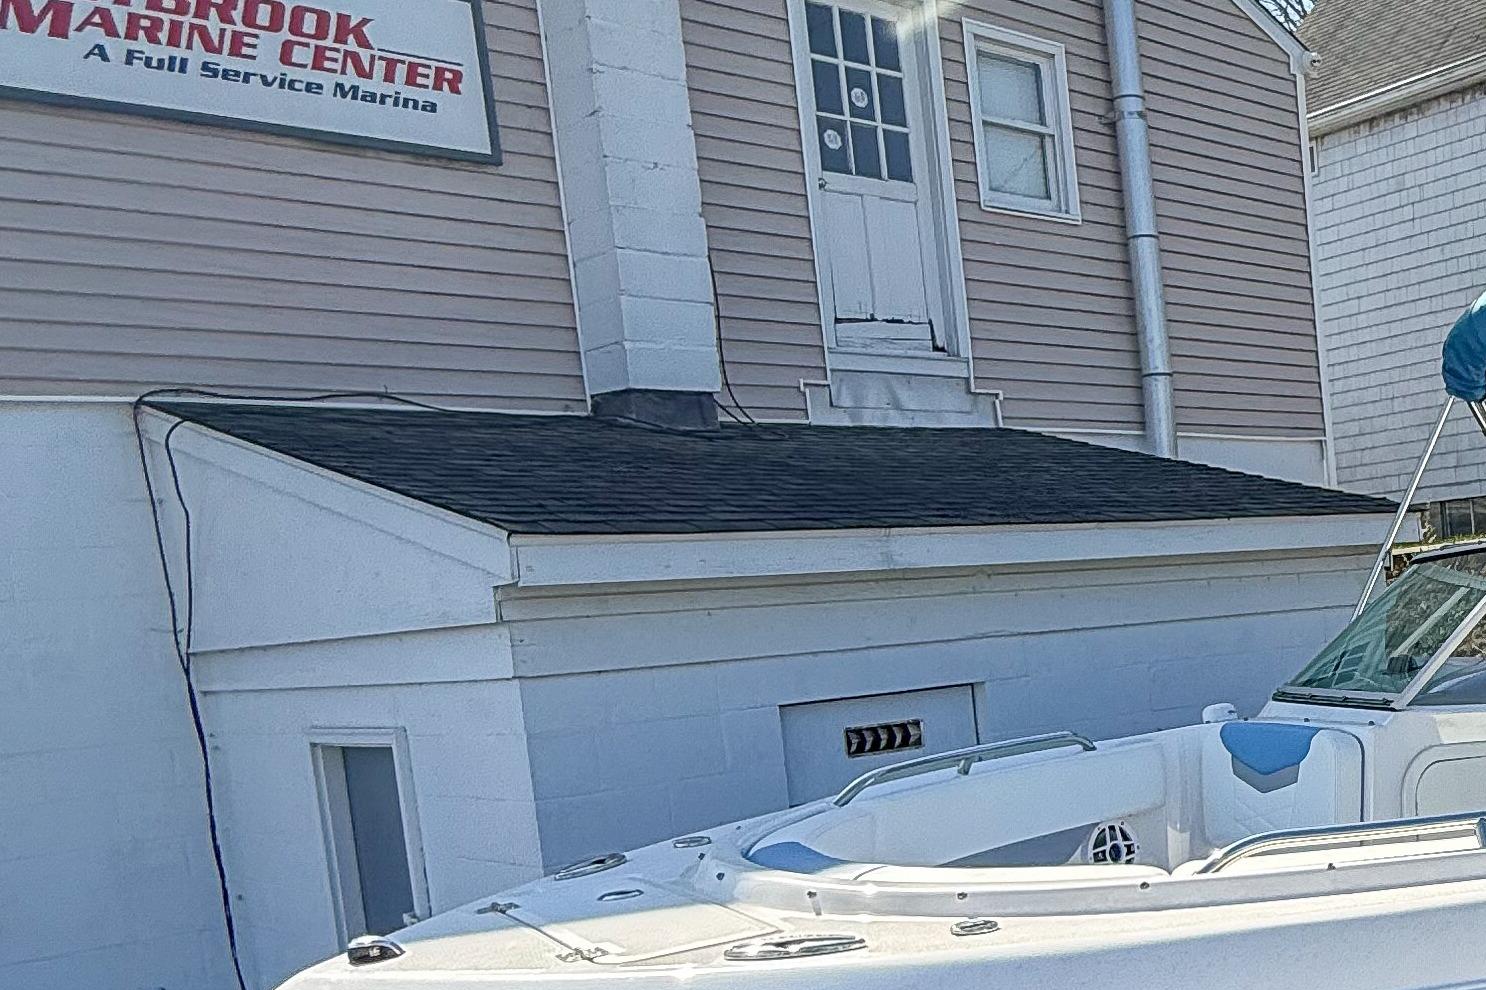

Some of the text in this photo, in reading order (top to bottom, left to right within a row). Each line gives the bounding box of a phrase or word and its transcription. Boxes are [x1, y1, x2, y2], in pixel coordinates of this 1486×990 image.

[0, 0, 464, 95] MARINE CENTER
[83, 43, 438, 114] A Full Service Marina
